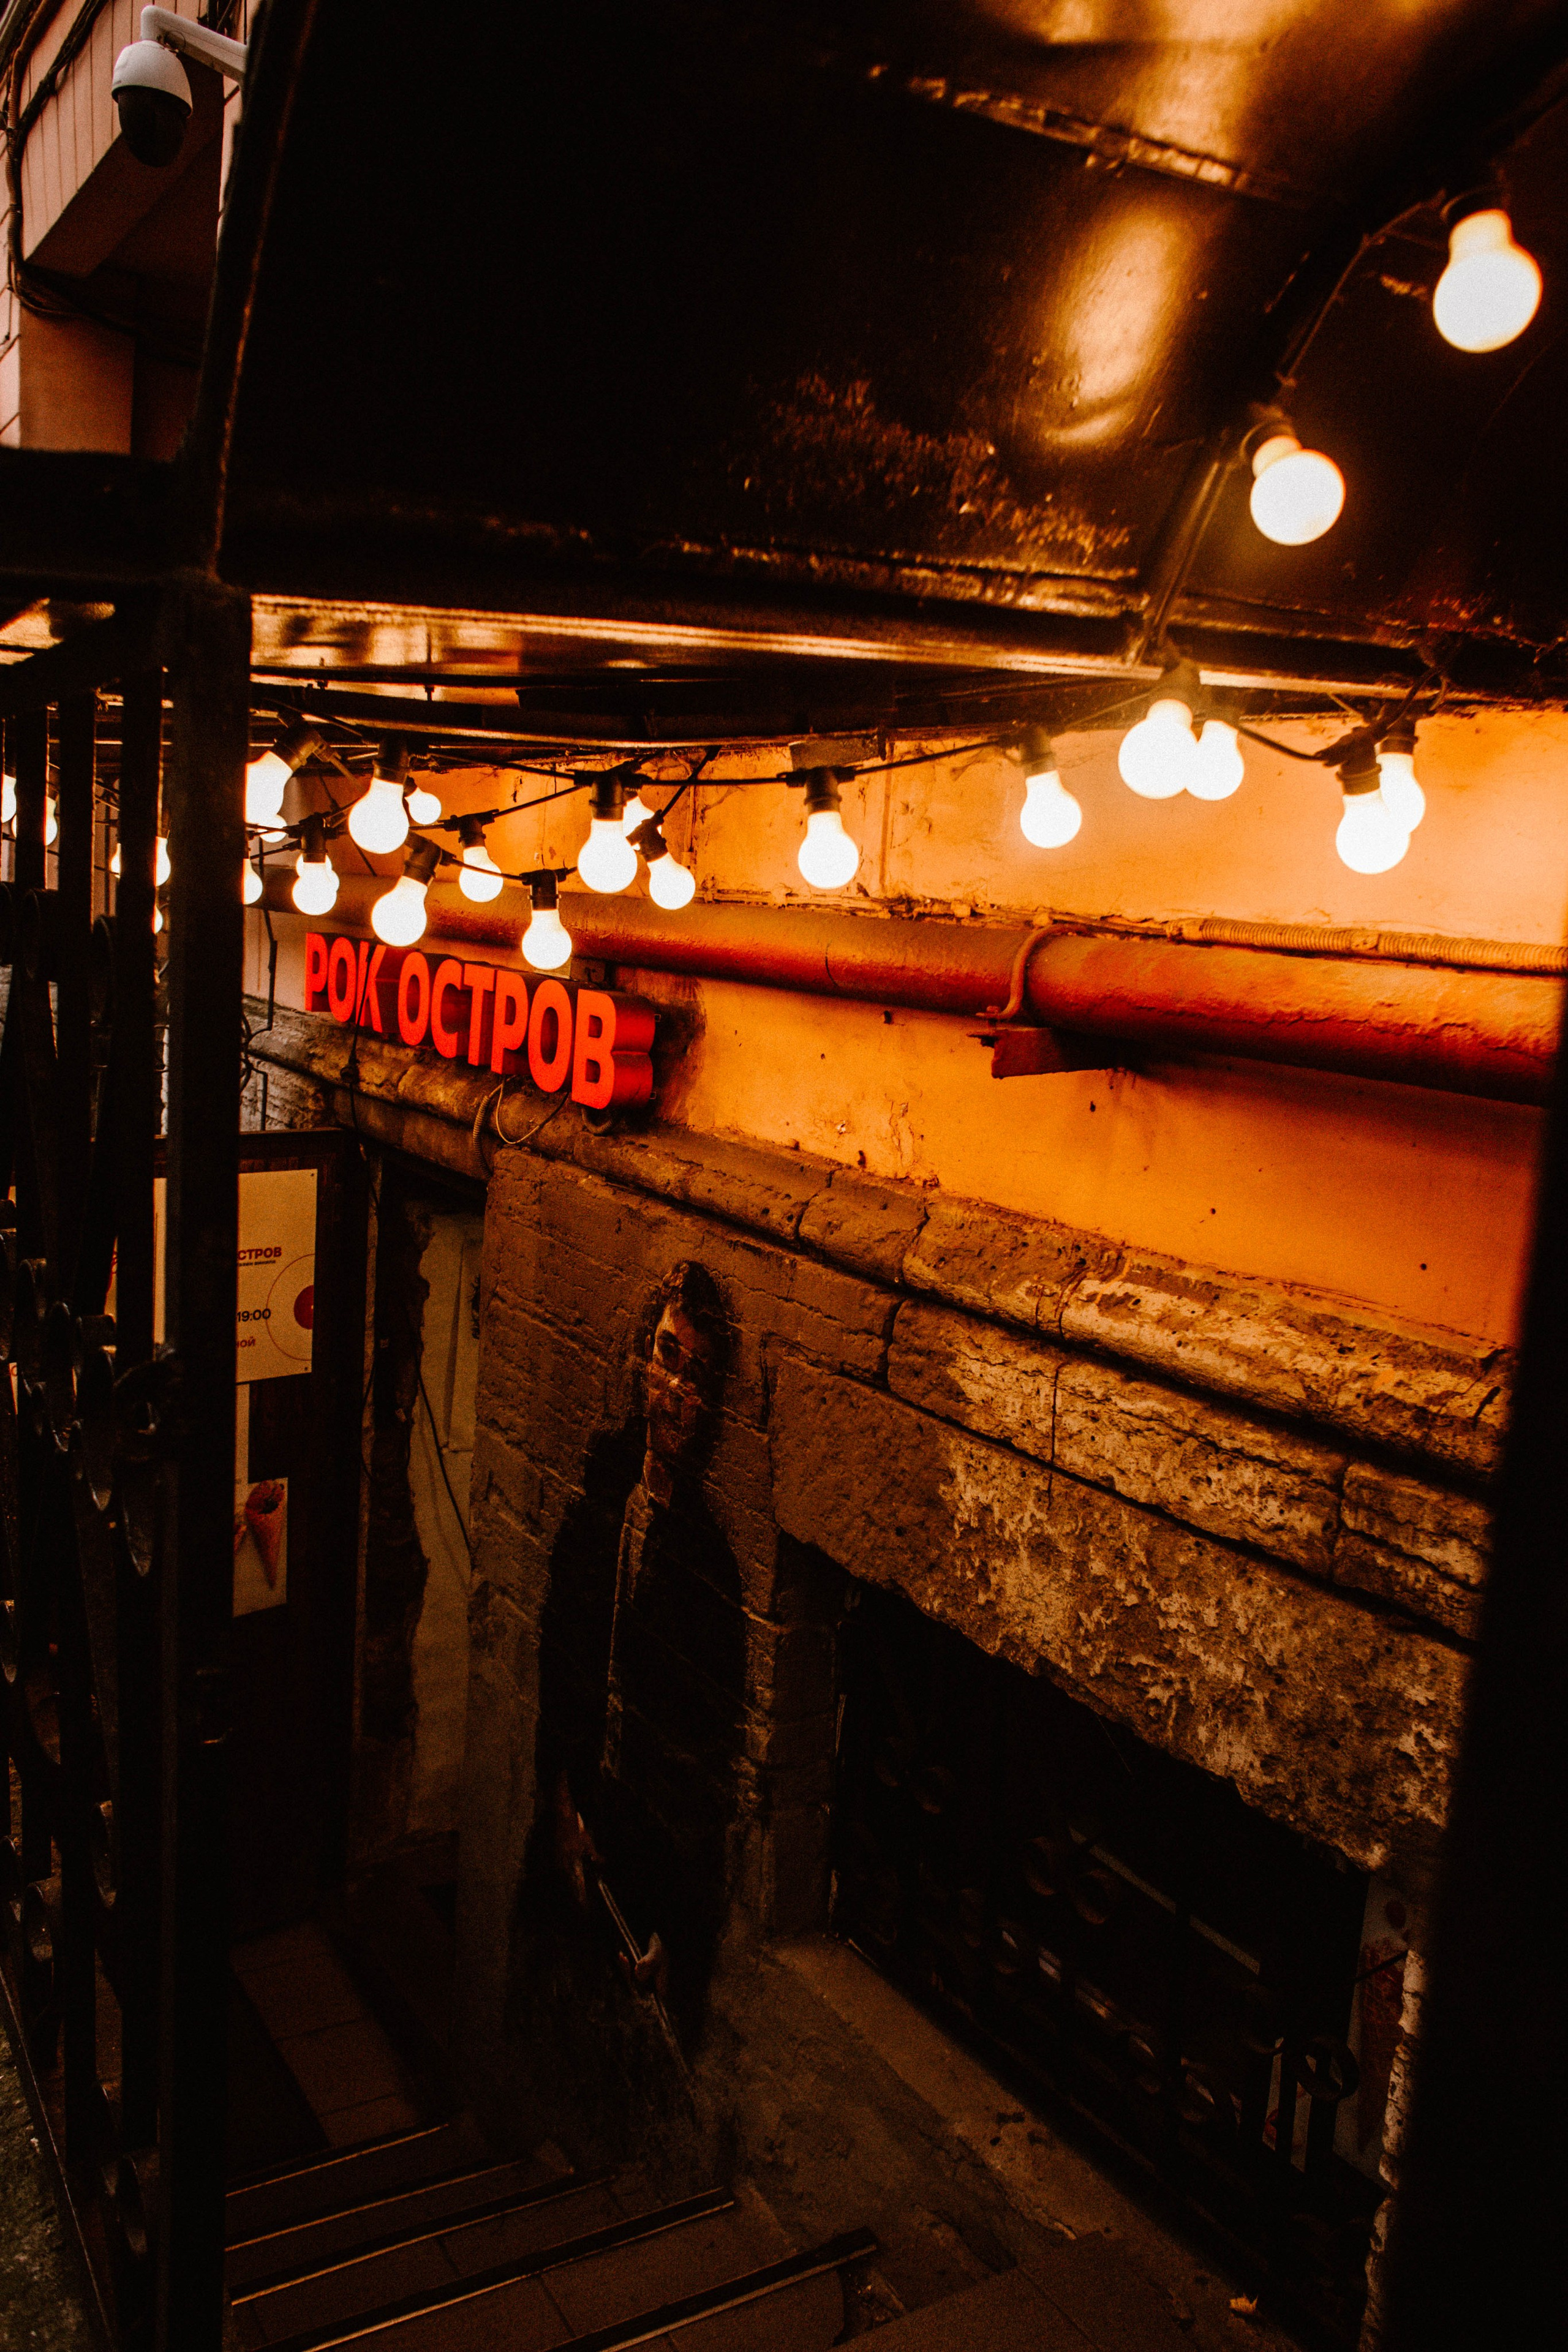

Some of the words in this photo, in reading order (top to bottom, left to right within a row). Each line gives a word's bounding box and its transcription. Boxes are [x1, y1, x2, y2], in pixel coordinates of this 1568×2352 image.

[305, 932, 386, 1033] РОК
[398, 951, 617, 1110] ОСТРОВ
[237, 1246, 282, 1260] СТРОВ
[237, 1308, 271, 1322] 19:00
